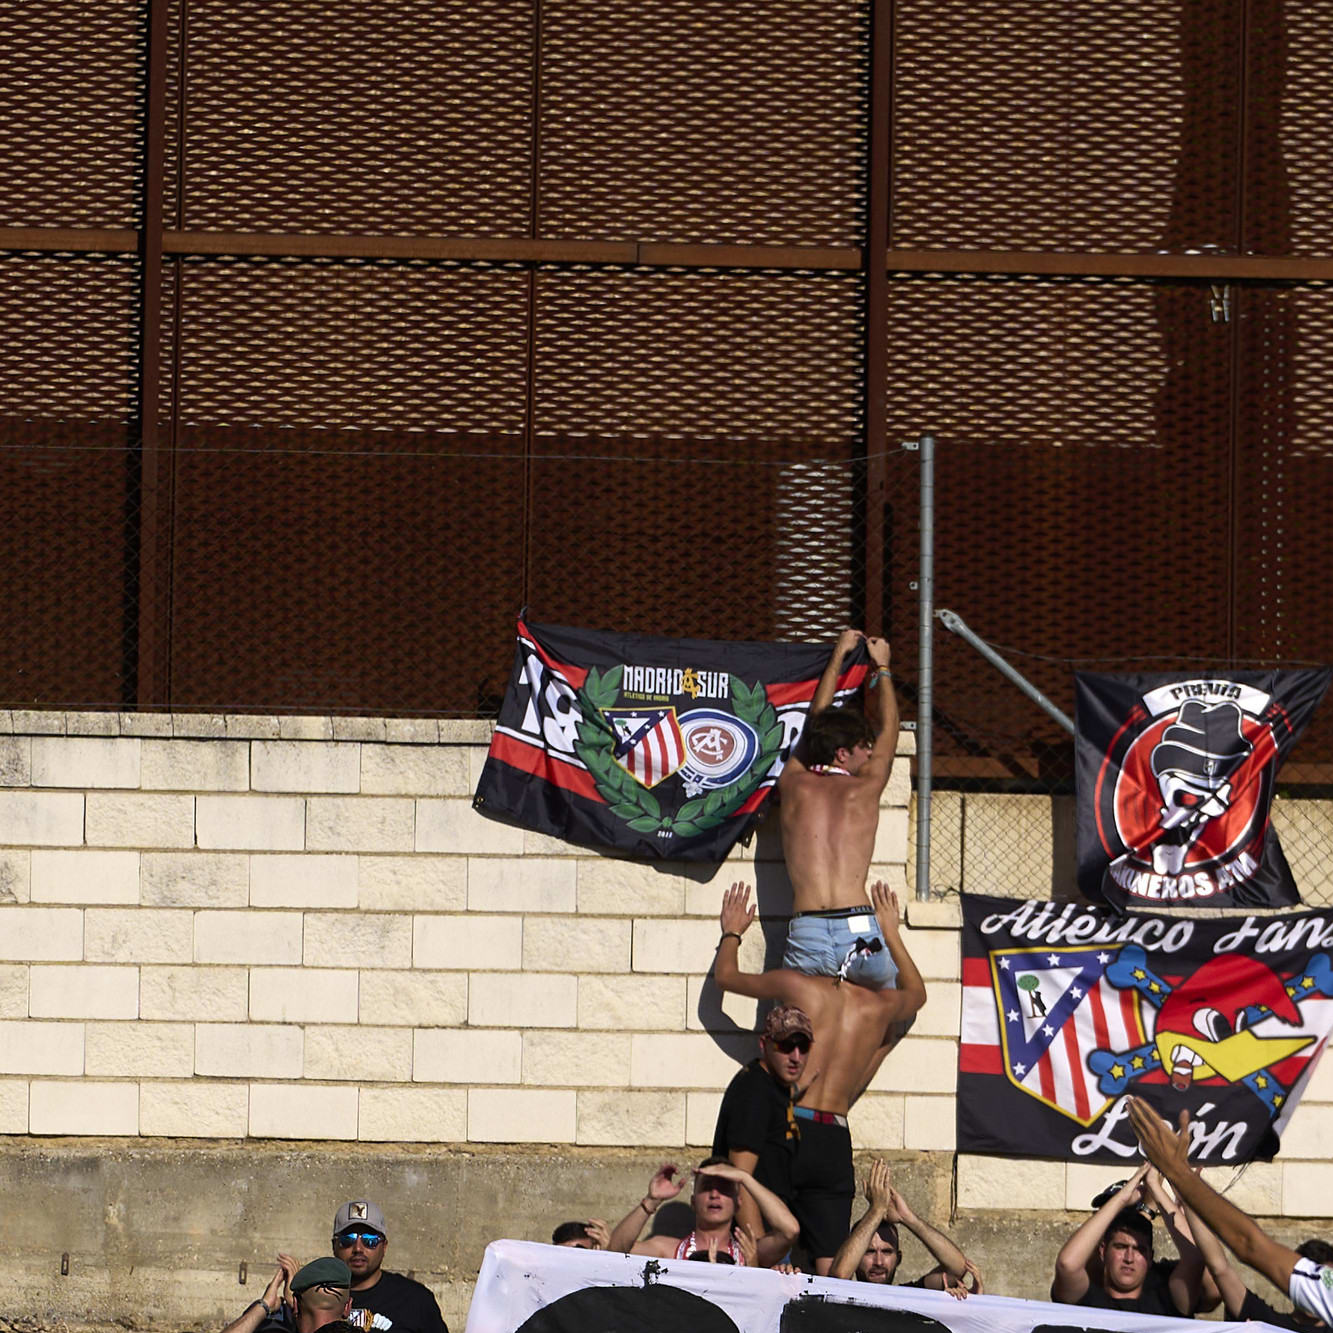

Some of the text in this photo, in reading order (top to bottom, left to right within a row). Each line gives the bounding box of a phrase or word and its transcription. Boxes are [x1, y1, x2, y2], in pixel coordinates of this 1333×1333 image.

[623, 664, 728, 699] MADRID SUR
[1071, 1094, 1247, 1160] Lón
